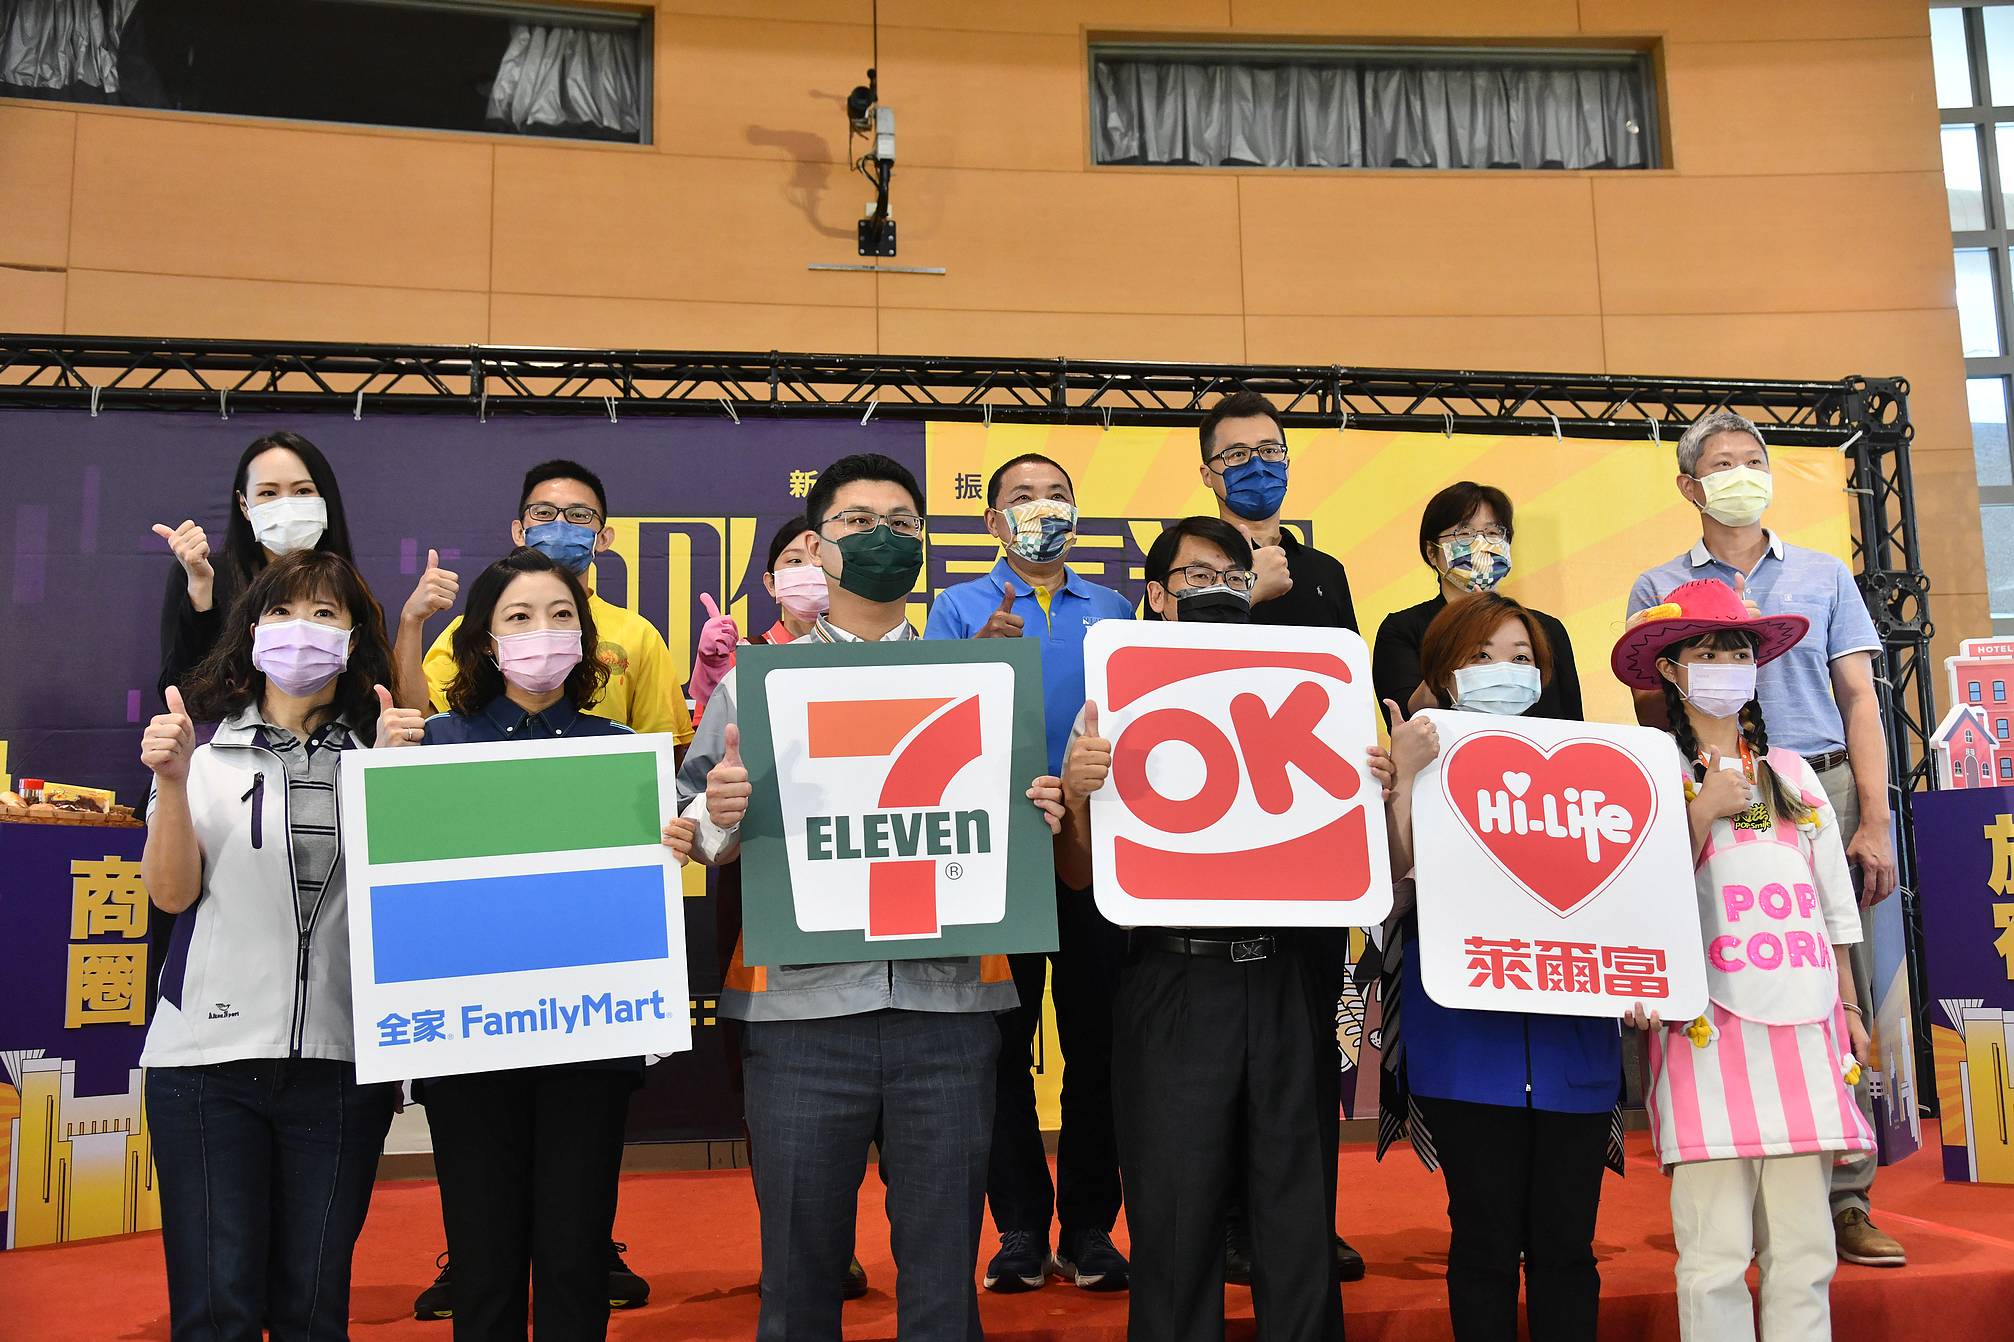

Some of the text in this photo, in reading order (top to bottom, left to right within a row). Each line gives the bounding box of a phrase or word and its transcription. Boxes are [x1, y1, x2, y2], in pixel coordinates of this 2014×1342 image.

[954, 472, 983, 500] 振
[1977, 645, 2013, 654] HOTEL
[1112, 681, 1361, 834] OK
[1722, 883, 1816, 922] POP
[1464, 936, 1670, 999] 萊爾富
[376, 1009, 446, 1047] 全家
[461, 989, 665, 1039] FamilyMart
